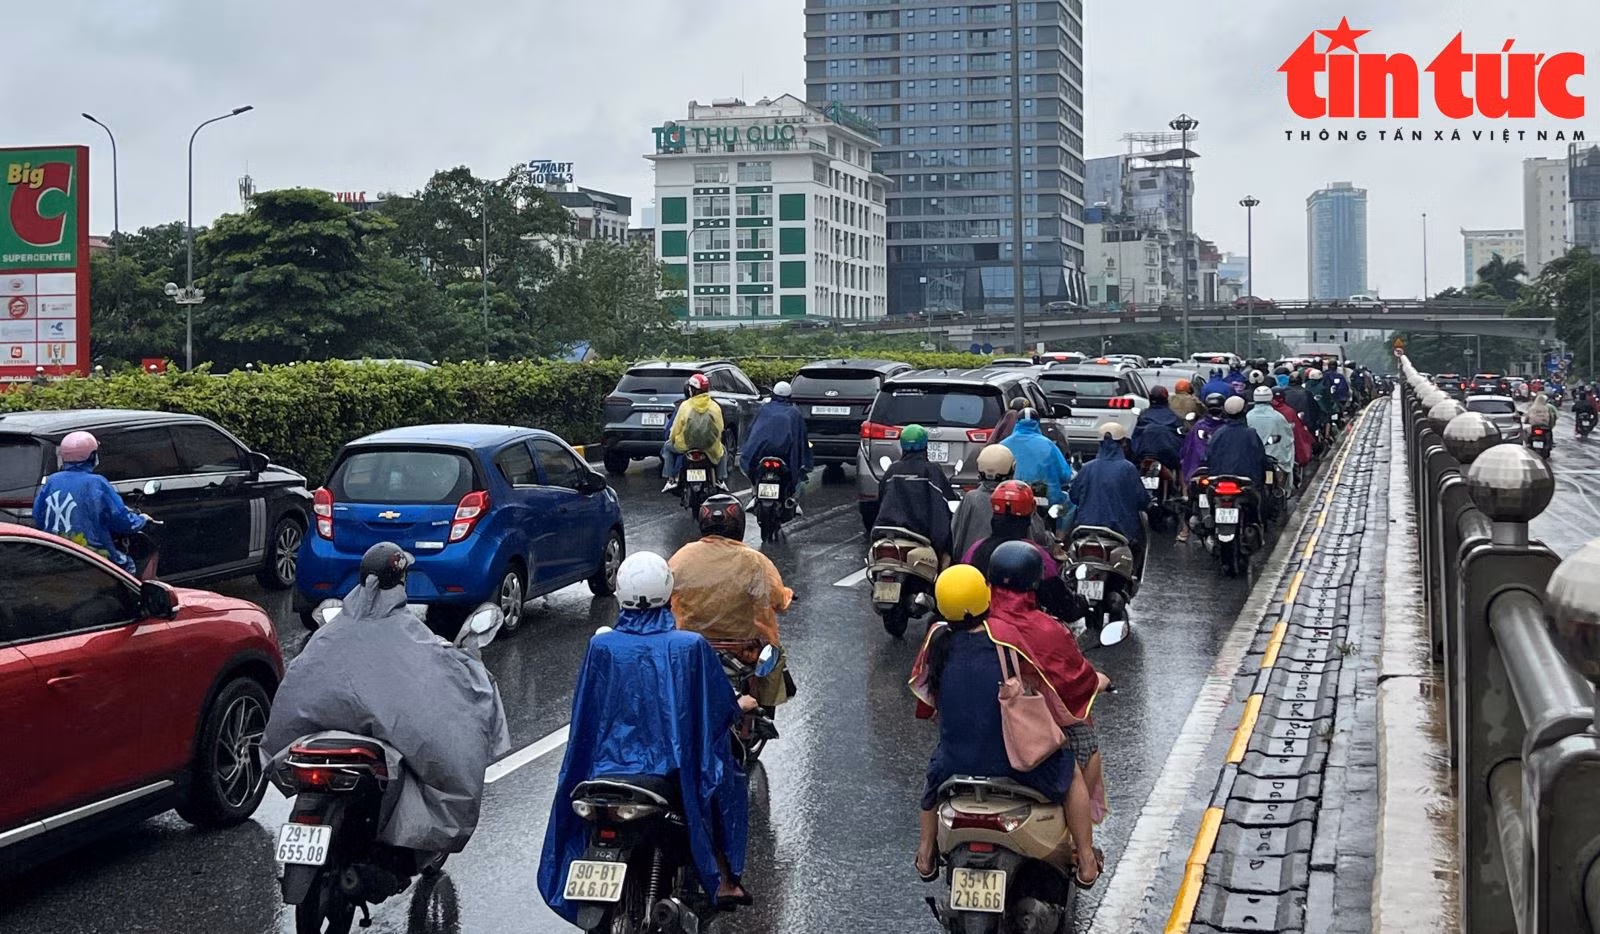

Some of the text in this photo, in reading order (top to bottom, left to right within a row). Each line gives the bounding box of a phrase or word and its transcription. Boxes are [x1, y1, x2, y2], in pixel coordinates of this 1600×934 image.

[7, 162, 45, 189] Big
[529, 160, 574, 173] SMART
[10, 161, 73, 247] C
[2, 253, 72, 263] SUPERCENTER
[285, 827, 322, 844] 29-Y1
[278, 844, 324, 863] 655.08
[576, 863, 617, 880] 90-B1
[960, 871, 997, 890] 35-K1
[567, 880, 619, 898] 346.07
[955, 891, 1000, 909] 216.66
